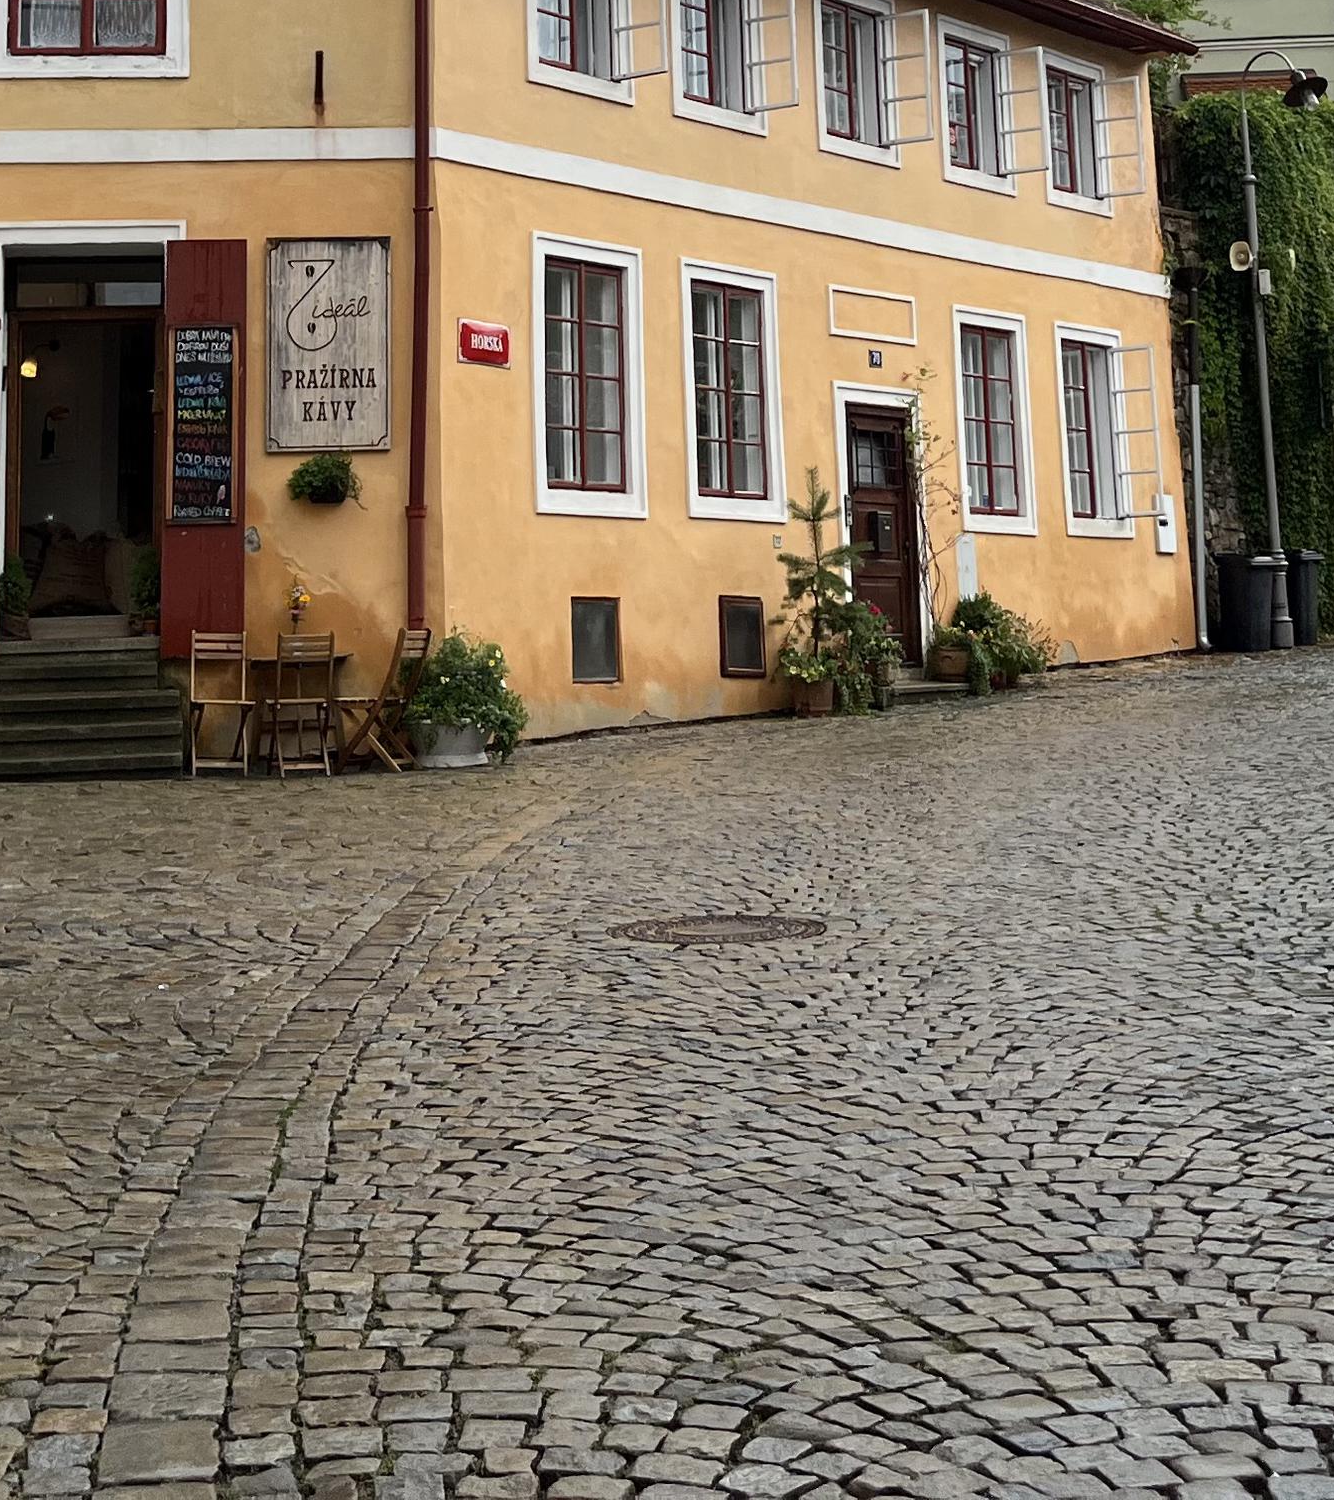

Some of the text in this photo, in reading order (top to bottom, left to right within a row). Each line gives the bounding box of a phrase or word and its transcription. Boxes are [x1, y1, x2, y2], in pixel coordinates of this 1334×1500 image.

[471, 333, 503, 352] HORSKÁ
[282, 364, 377, 390] PRAŽÍRNA
[302, 396, 357, 422] KÁVY
[175, 452, 232, 468] COLD BREW
